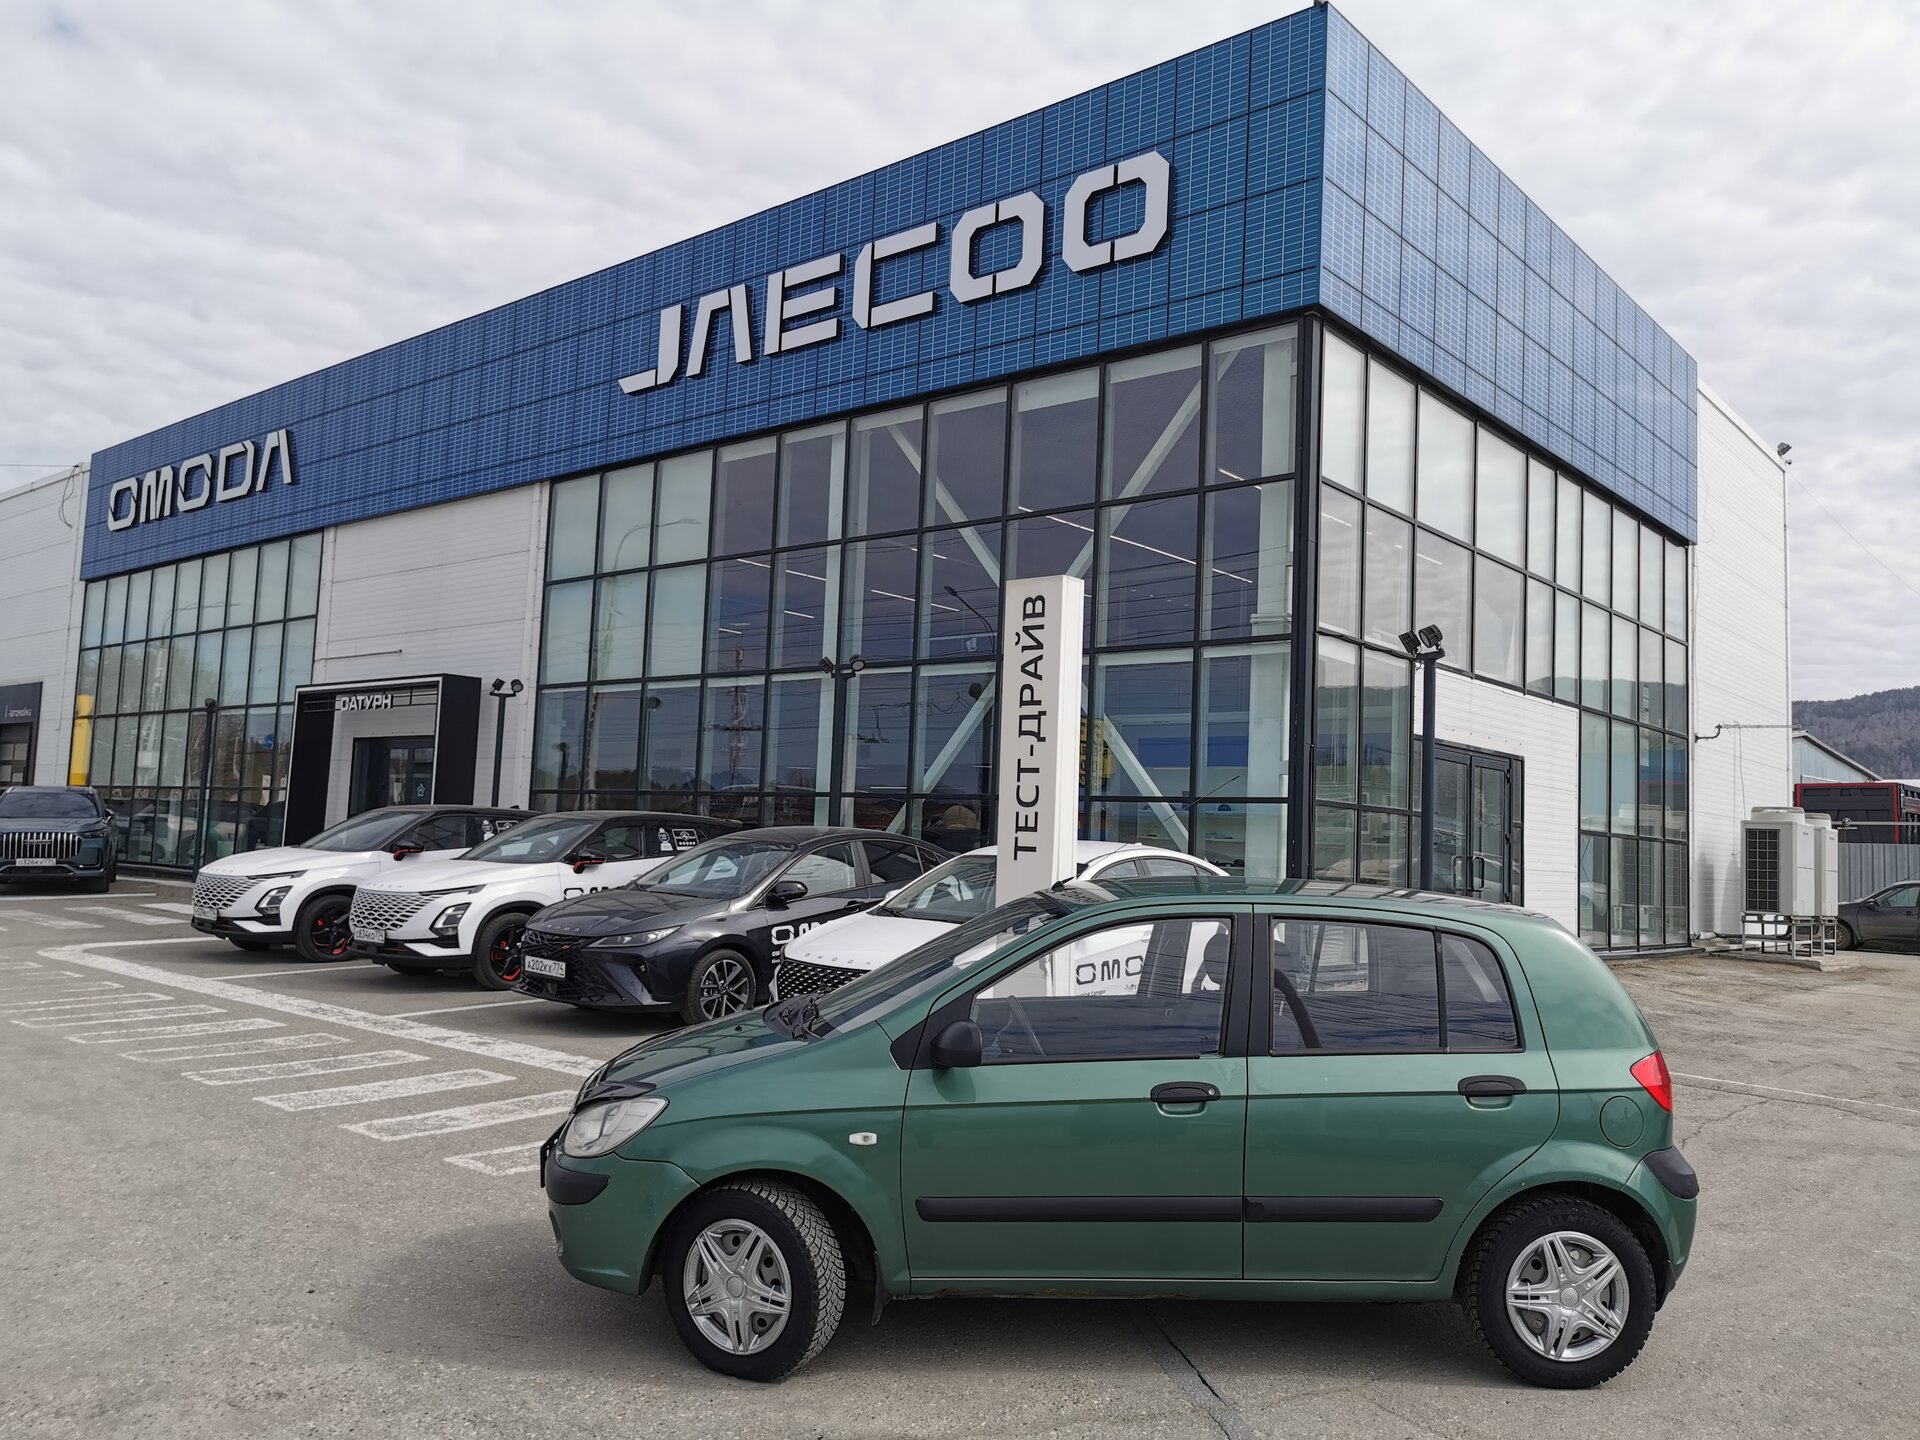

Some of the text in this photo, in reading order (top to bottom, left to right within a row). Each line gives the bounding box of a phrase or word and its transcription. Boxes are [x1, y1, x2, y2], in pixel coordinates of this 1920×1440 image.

[617, 151, 1170, 395] JAECOO
[107, 428, 292, 532] OMODA
[340, 694, 392, 711] САТУРН
[1013, 593, 1047, 861] ТЕСТ-ДРАЙВ
